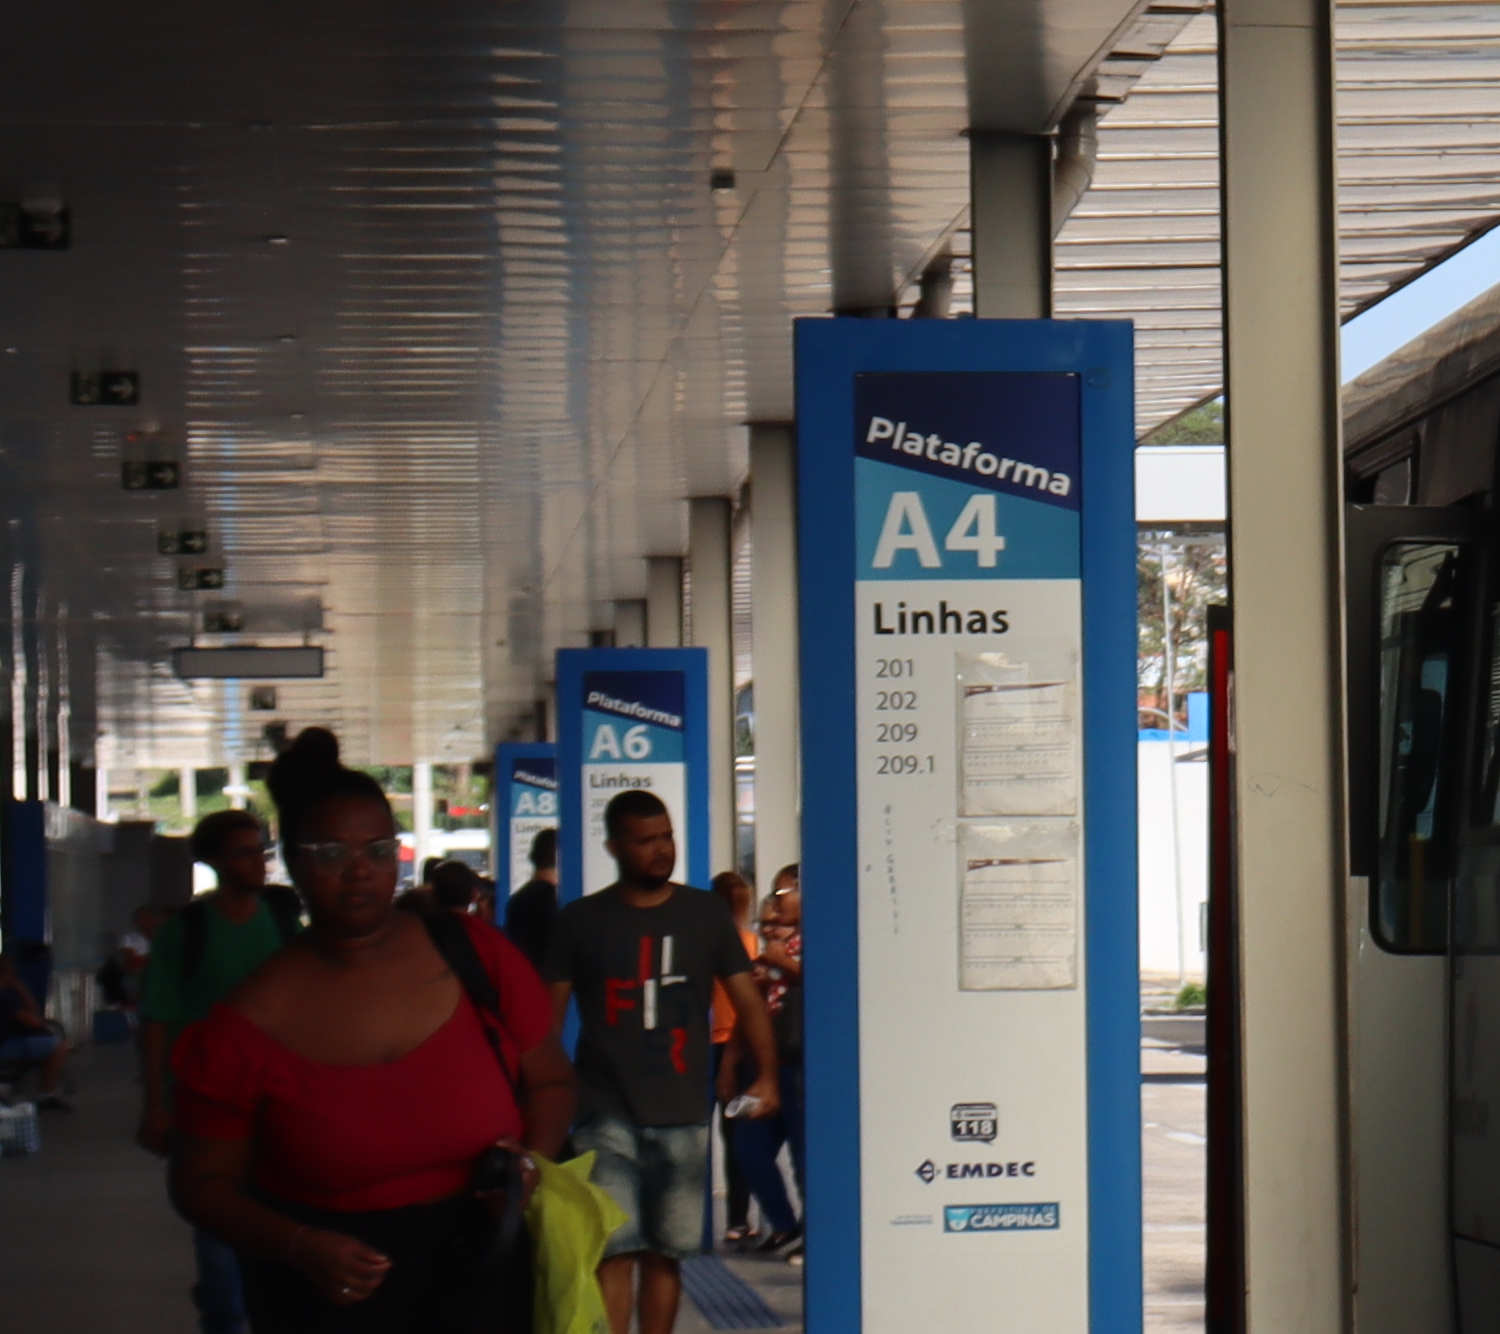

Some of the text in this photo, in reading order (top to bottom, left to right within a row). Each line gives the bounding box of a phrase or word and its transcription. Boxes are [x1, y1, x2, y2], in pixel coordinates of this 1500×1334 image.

[866, 415, 1072, 498] Plataforma
[870, 490, 1007, 570] A4
[873, 601, 1010, 636] Linhas
[876, 658, 916, 678] 201
[587, 691, 682, 727] Plataforma
[876, 691, 918, 711] 202
[589, 723, 653, 760] A6
[876, 723, 918, 743] 209
[876, 754, 936, 775] 209.1
[589, 773, 653, 789] Linhas
[516, 791, 556, 815] A8
[955, 1120, 994, 1136] 118
[946, 1160, 1037, 1180] EMDEC
[970, 1212, 1057, 1229] CAMPINAS
